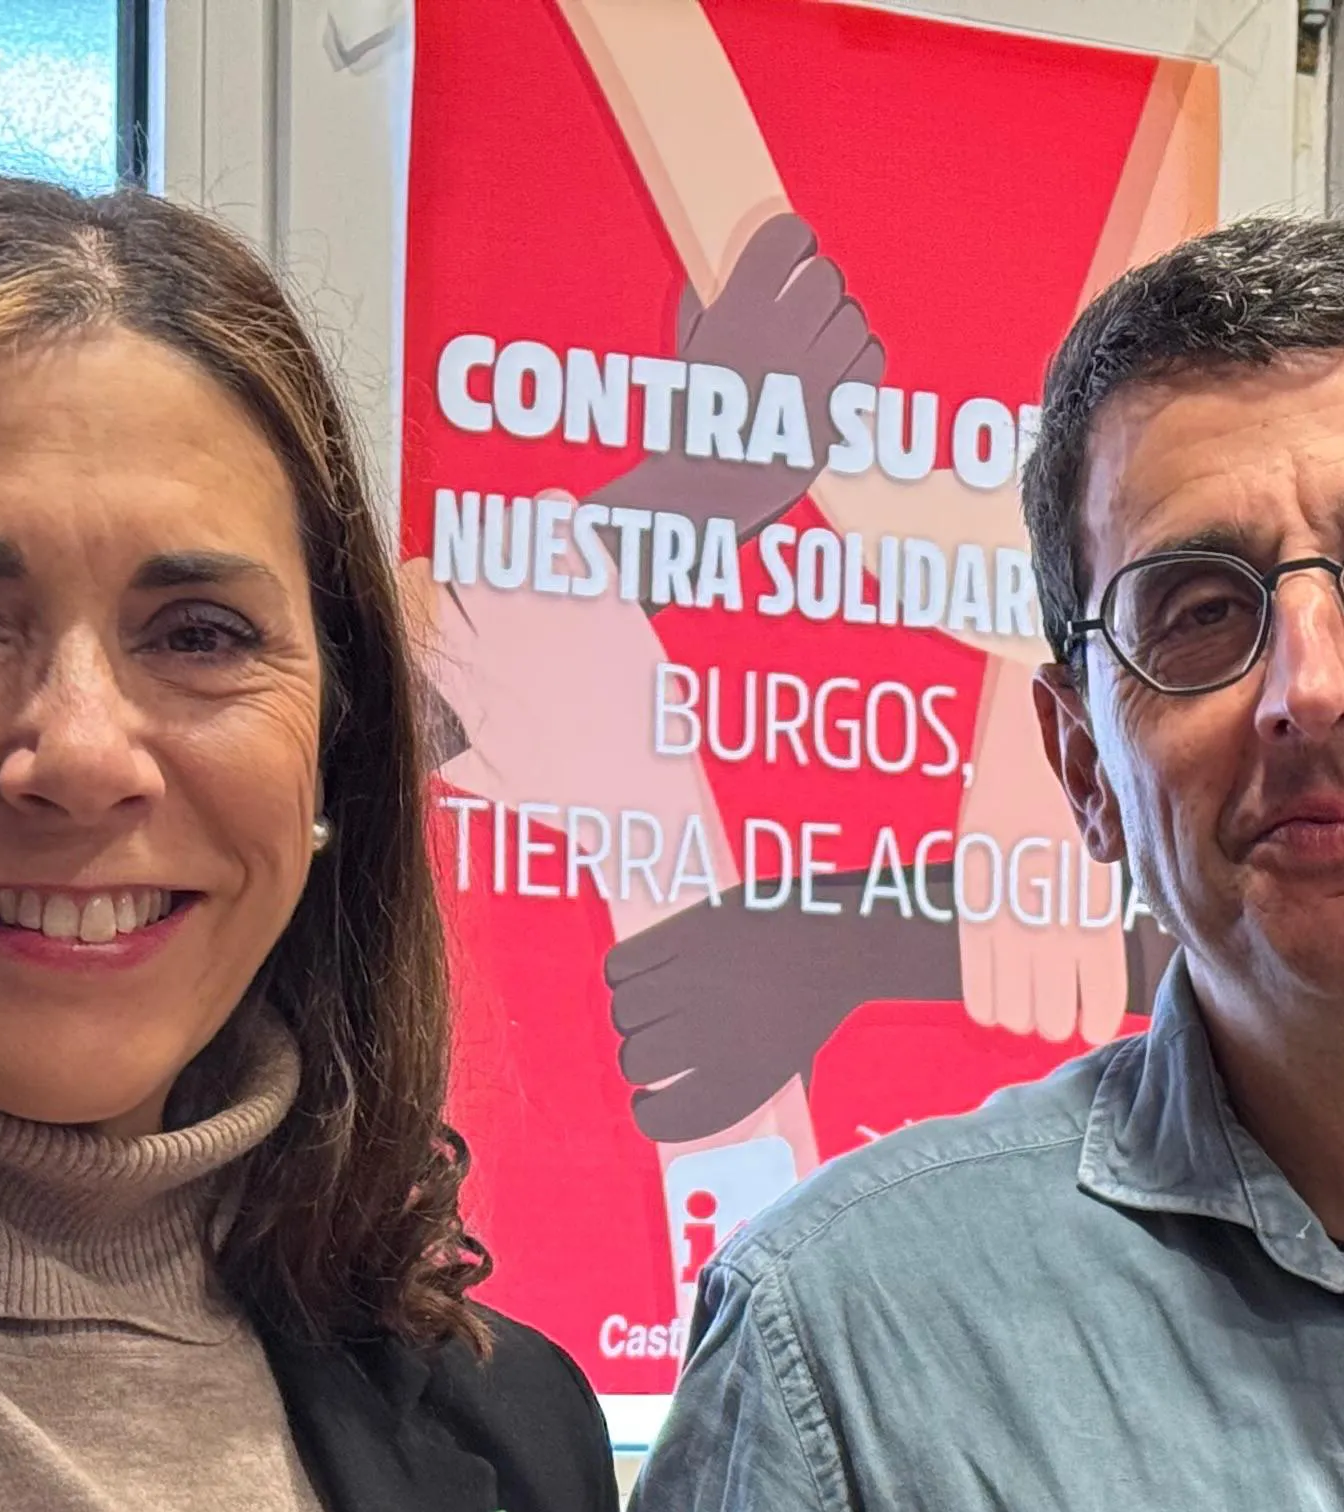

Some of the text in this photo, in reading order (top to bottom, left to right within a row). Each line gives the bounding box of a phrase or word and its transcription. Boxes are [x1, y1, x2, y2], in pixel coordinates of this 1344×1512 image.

[436, 333, 816, 470] CONTRA
[826, 380, 939, 482] SU
[431, 487, 1048, 637] NUESTRA SOLIDAR
[655, 661, 974, 789] BURGOS,
[437, 795, 723, 908] TIERRA
[743, 816, 844, 915] DE
[598, 1313, 687, 1358] Cast
